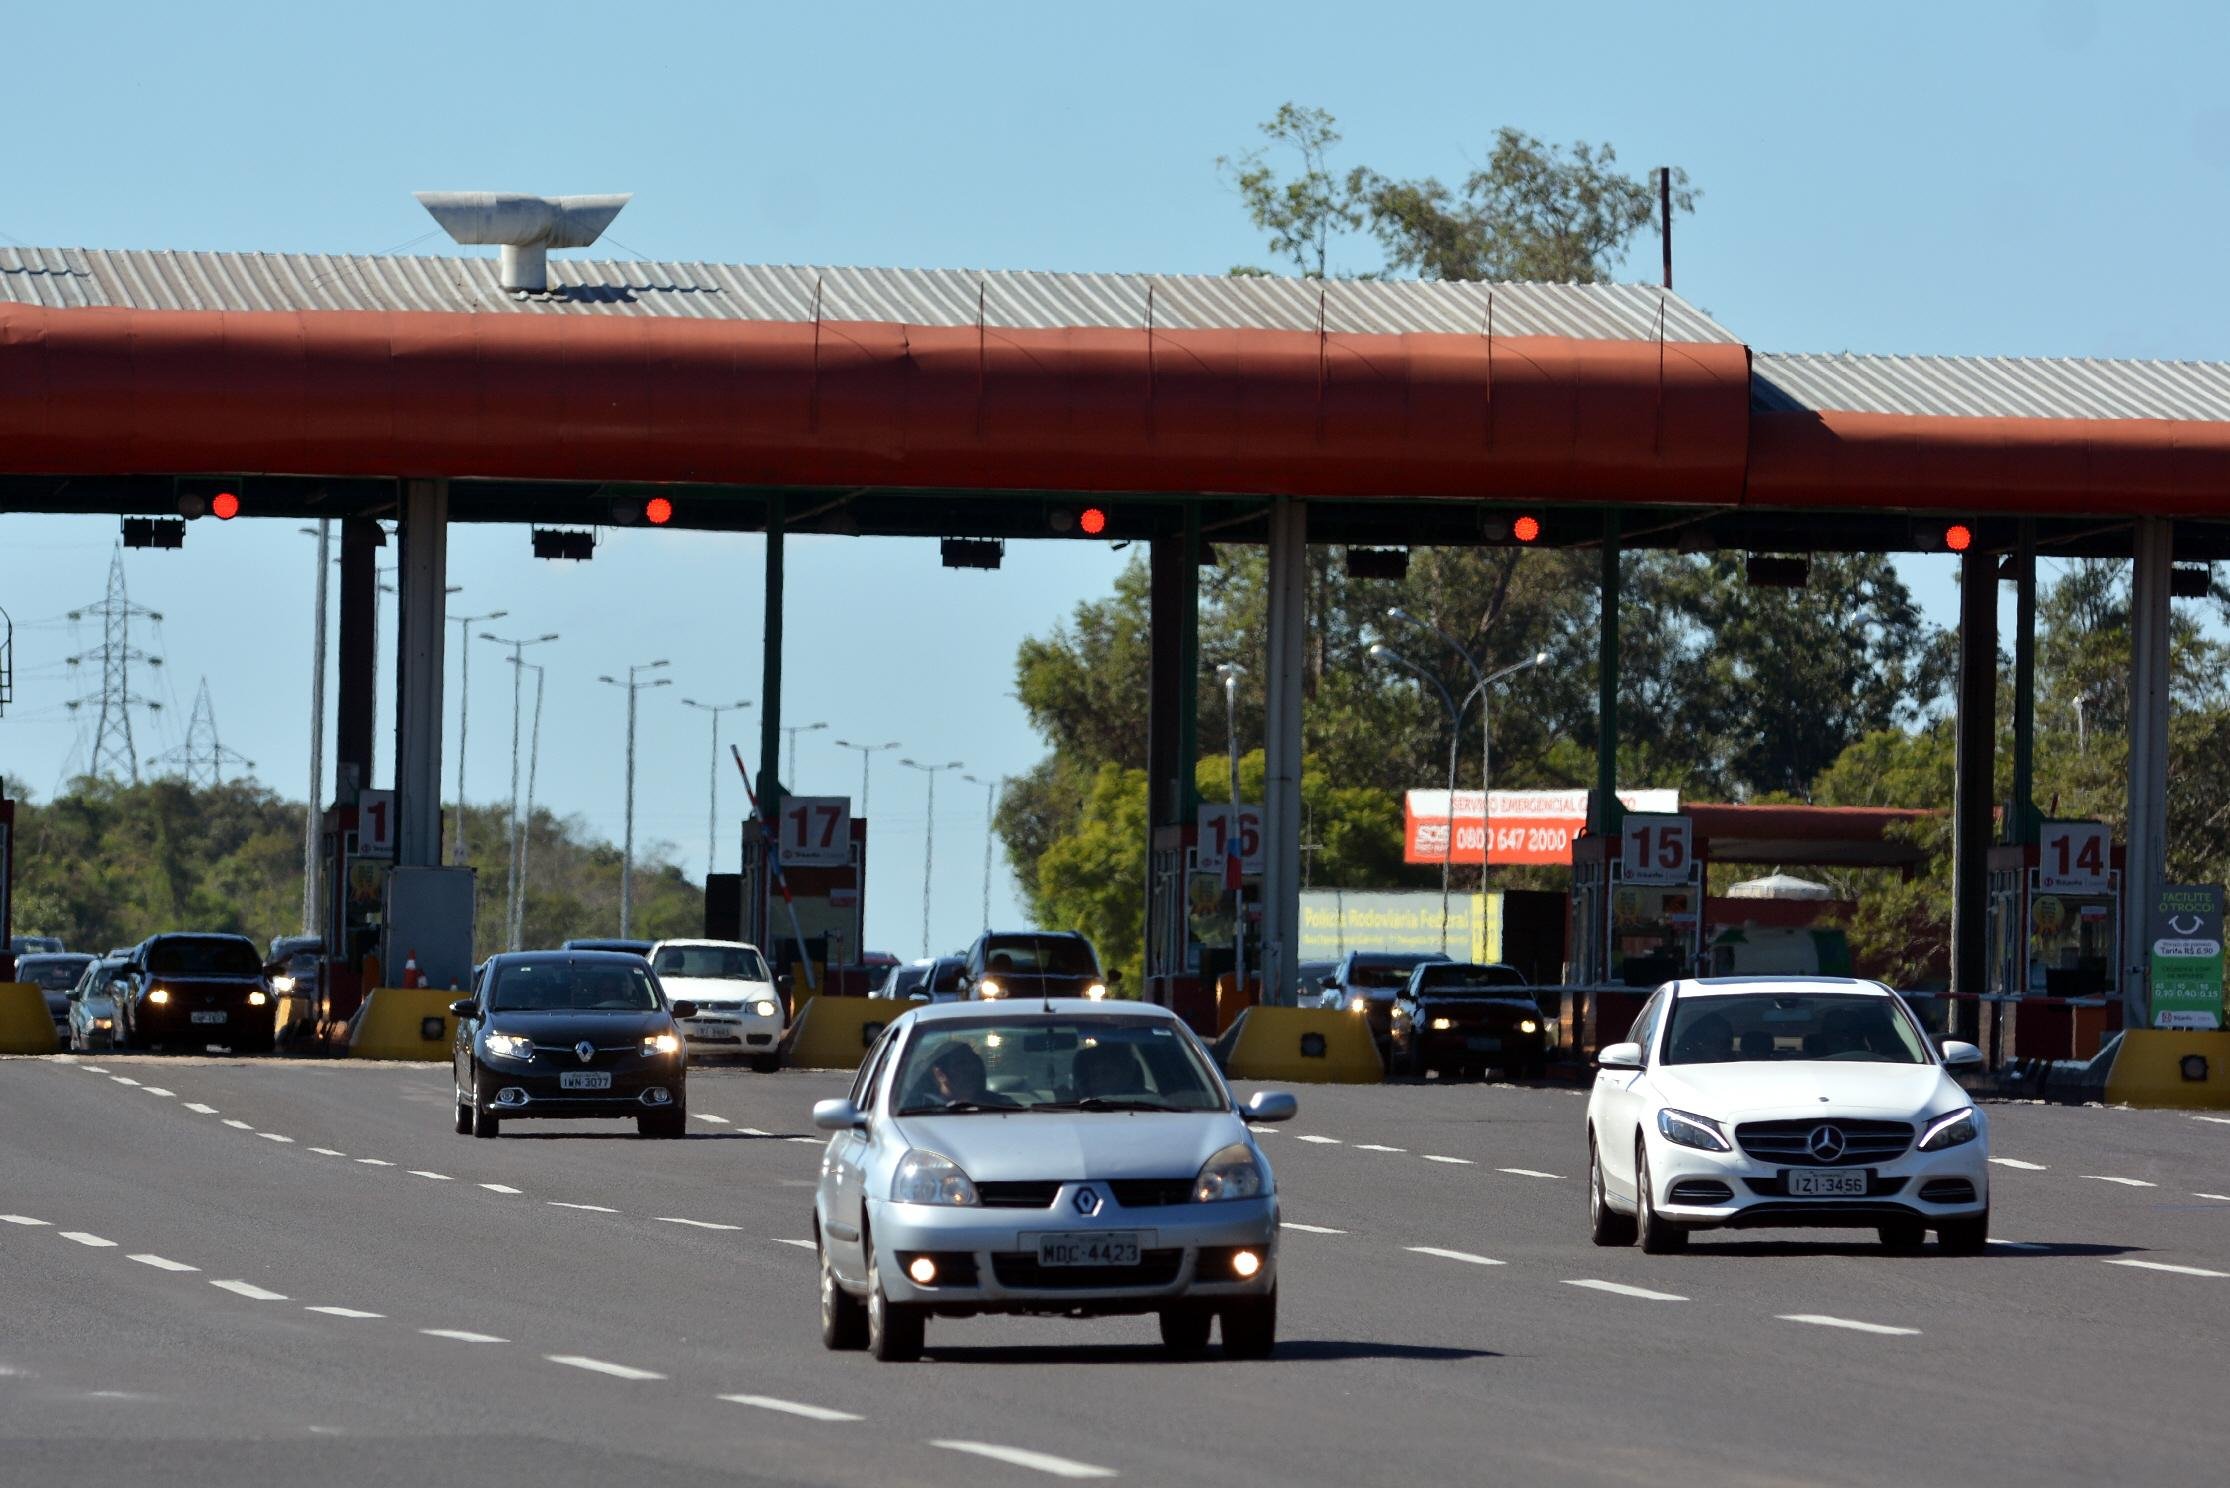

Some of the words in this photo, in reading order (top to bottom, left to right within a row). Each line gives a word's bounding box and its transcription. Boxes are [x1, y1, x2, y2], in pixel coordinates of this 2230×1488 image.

[788, 805, 842, 848] 17
[1208, 813, 1259, 857] 16
[1456, 827, 1494, 849] 0800
[1497, 828, 1525, 851] 647
[1528, 828, 1566, 851] 2000
[1631, 826, 1684, 869] 15
[2051, 834, 2104, 876] 14
[2159, 903, 2168, 912] O
[2162, 892, 2212, 902] FACILITE
